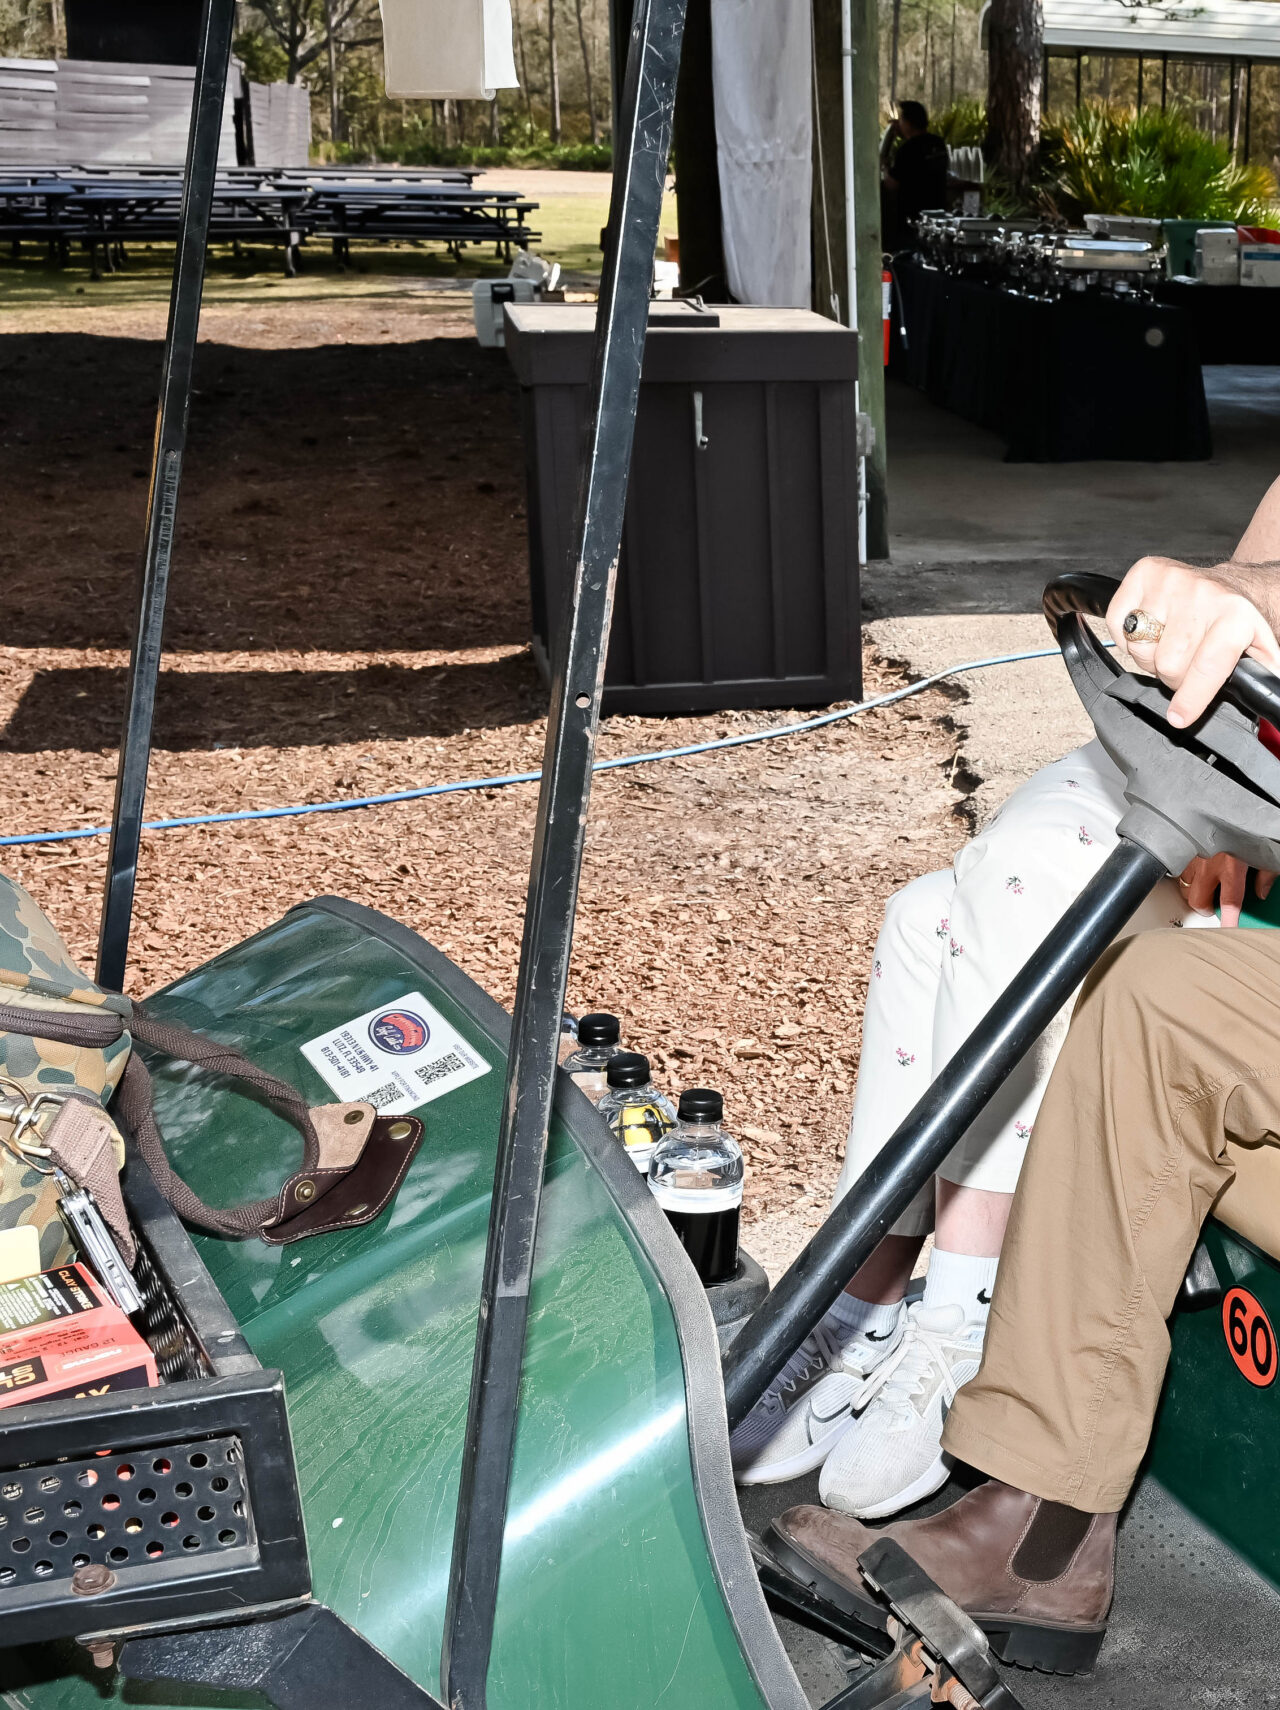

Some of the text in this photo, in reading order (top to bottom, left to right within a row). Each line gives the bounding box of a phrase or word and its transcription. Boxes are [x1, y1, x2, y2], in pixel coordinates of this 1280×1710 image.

[321, 1046, 351, 1079] 813-501-4181
[340, 1030, 357, 1046] 19313
[359, 1053, 374, 1066] HWY
[369, 1064, 379, 1072] 41
[342, 1050, 352, 1059] FL
[346, 1055, 366, 1074] 33549
[58, 1270, 94, 1310] CLAY STRIKE
[1229, 1296, 1272, 1376] 60
